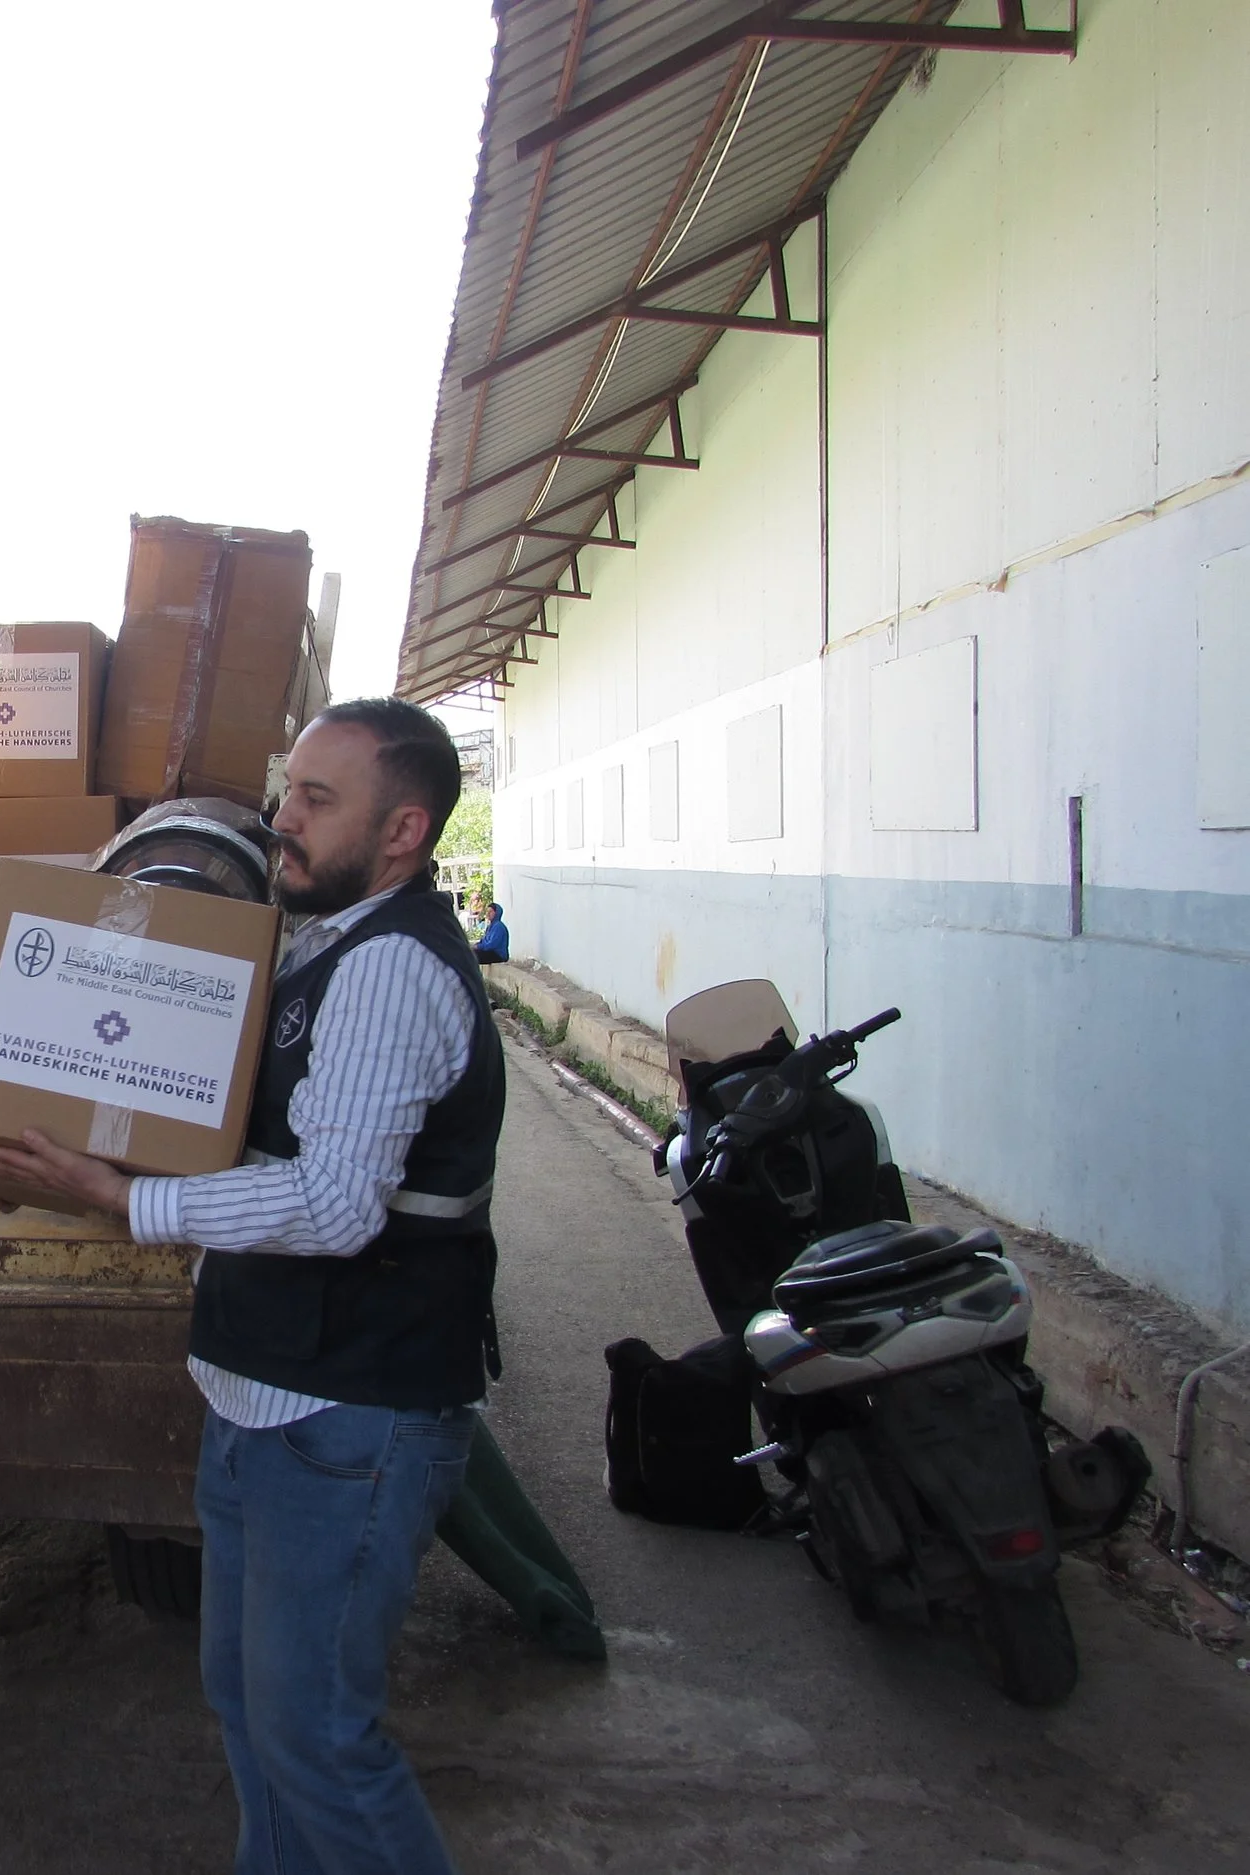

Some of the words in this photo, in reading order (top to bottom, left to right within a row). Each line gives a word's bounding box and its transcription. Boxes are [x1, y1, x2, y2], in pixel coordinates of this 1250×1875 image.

[57, 973, 74, 984] The
[76, 978, 108, 992] Middle
[112, 985, 132, 996] East
[135, 989, 172, 1005] Council
[174, 999, 184, 1007] of
[187, 1001, 232, 1018] Churches
[115, 1072, 215, 1104] HANNOVERS
